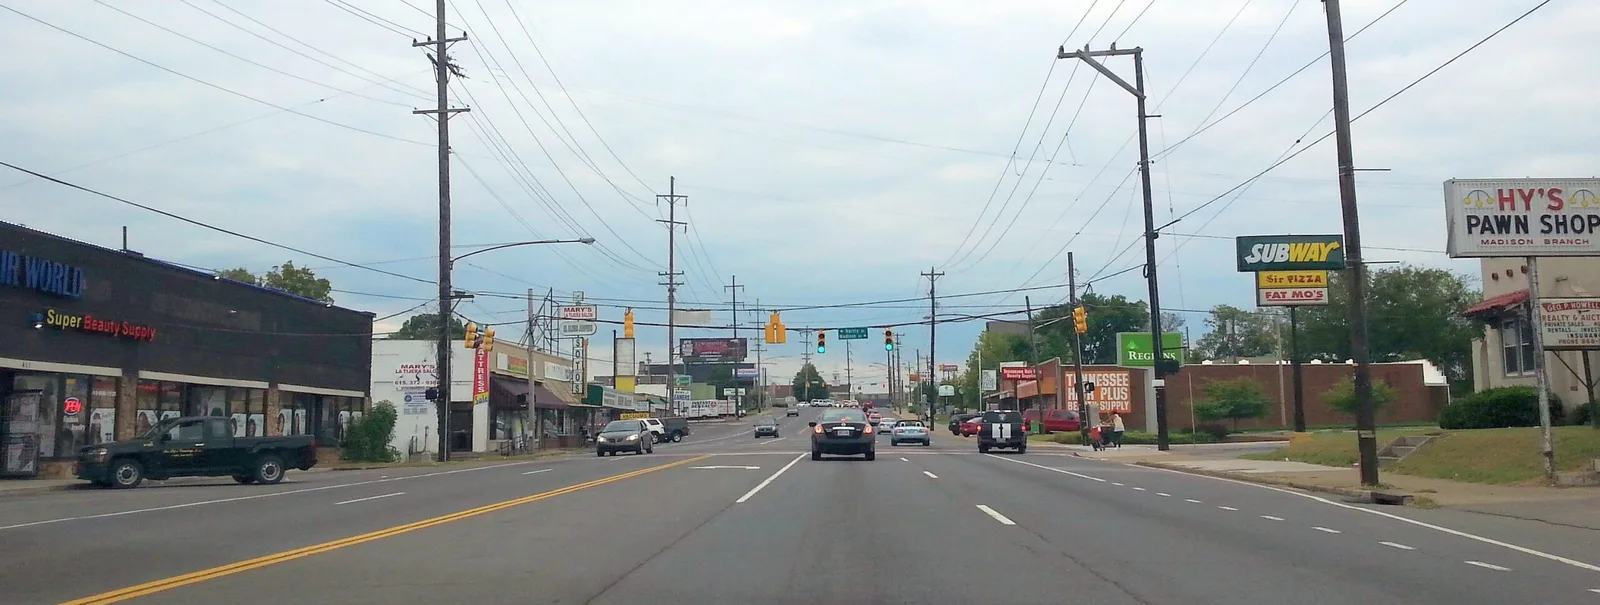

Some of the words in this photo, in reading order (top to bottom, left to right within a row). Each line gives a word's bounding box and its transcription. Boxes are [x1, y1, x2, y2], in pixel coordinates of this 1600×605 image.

[1497, 188, 1565, 211] HY'S
[1466, 214, 1529, 235] PAWN
[1540, 214, 1600, 235] SHOP
[1245, 241, 1340, 264] SUBWAY
[25, 255, 84, 298] WORLD
[1266, 274, 1284, 283] Sir
[1265, 291, 1287, 299] FAT
[1291, 290, 1324, 298] MO'S
[46, 308, 82, 330] Super
[83, 313, 120, 337] Beauty
[121, 320, 156, 342] Supply
[1128, 350, 1176, 360] REGINS
[1066, 373, 1129, 387] TNNESSEE
[475, 395, 488, 405] Sale
[1101, 386, 1129, 401] PLUS
[1100, 401, 1130, 411] SUPPLY
